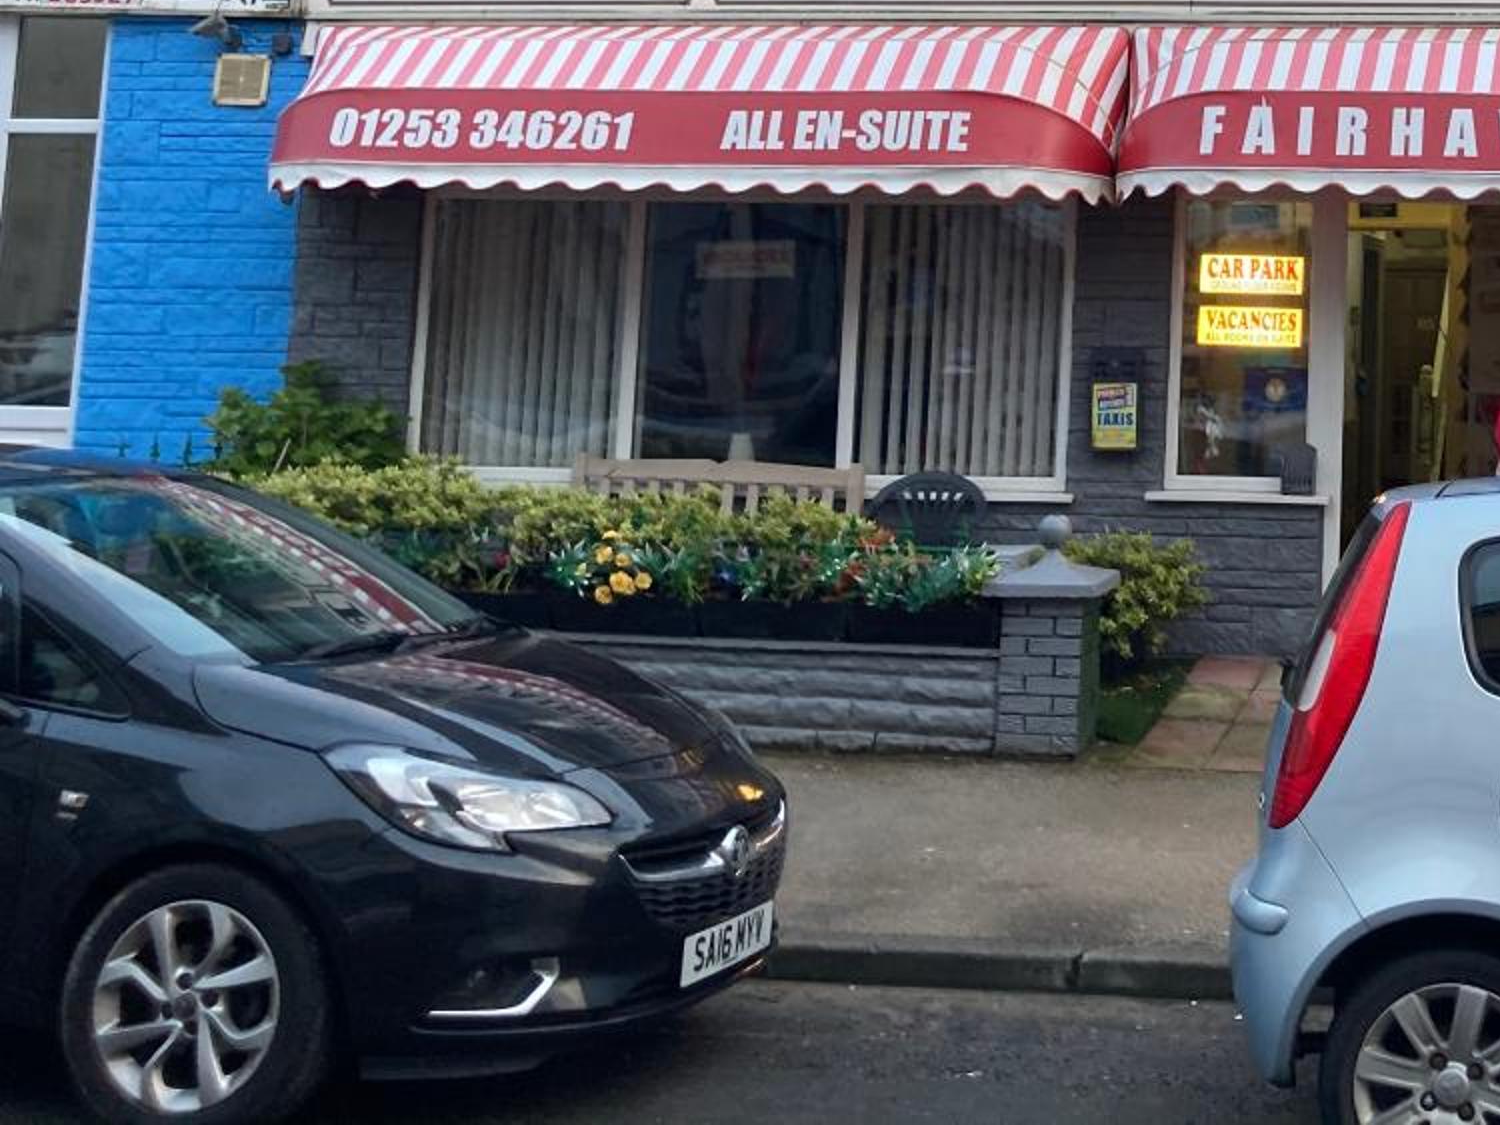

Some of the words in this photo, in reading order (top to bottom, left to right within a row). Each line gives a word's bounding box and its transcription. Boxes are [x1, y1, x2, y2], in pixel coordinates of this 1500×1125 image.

[329, 108, 461, 150] 01253
[469, 109, 635, 152] 346261
[720, 110, 796, 151] ALL
[797, 110, 972, 153] EN-SUITE
[1207, 257, 1243, 279] CAR
[1250, 258, 1299, 281] PARK
[1206, 309, 1298, 331] VACANCIES
[1096, 412, 1134, 426] TAXIS
[693, 925, 733, 972] SA16
